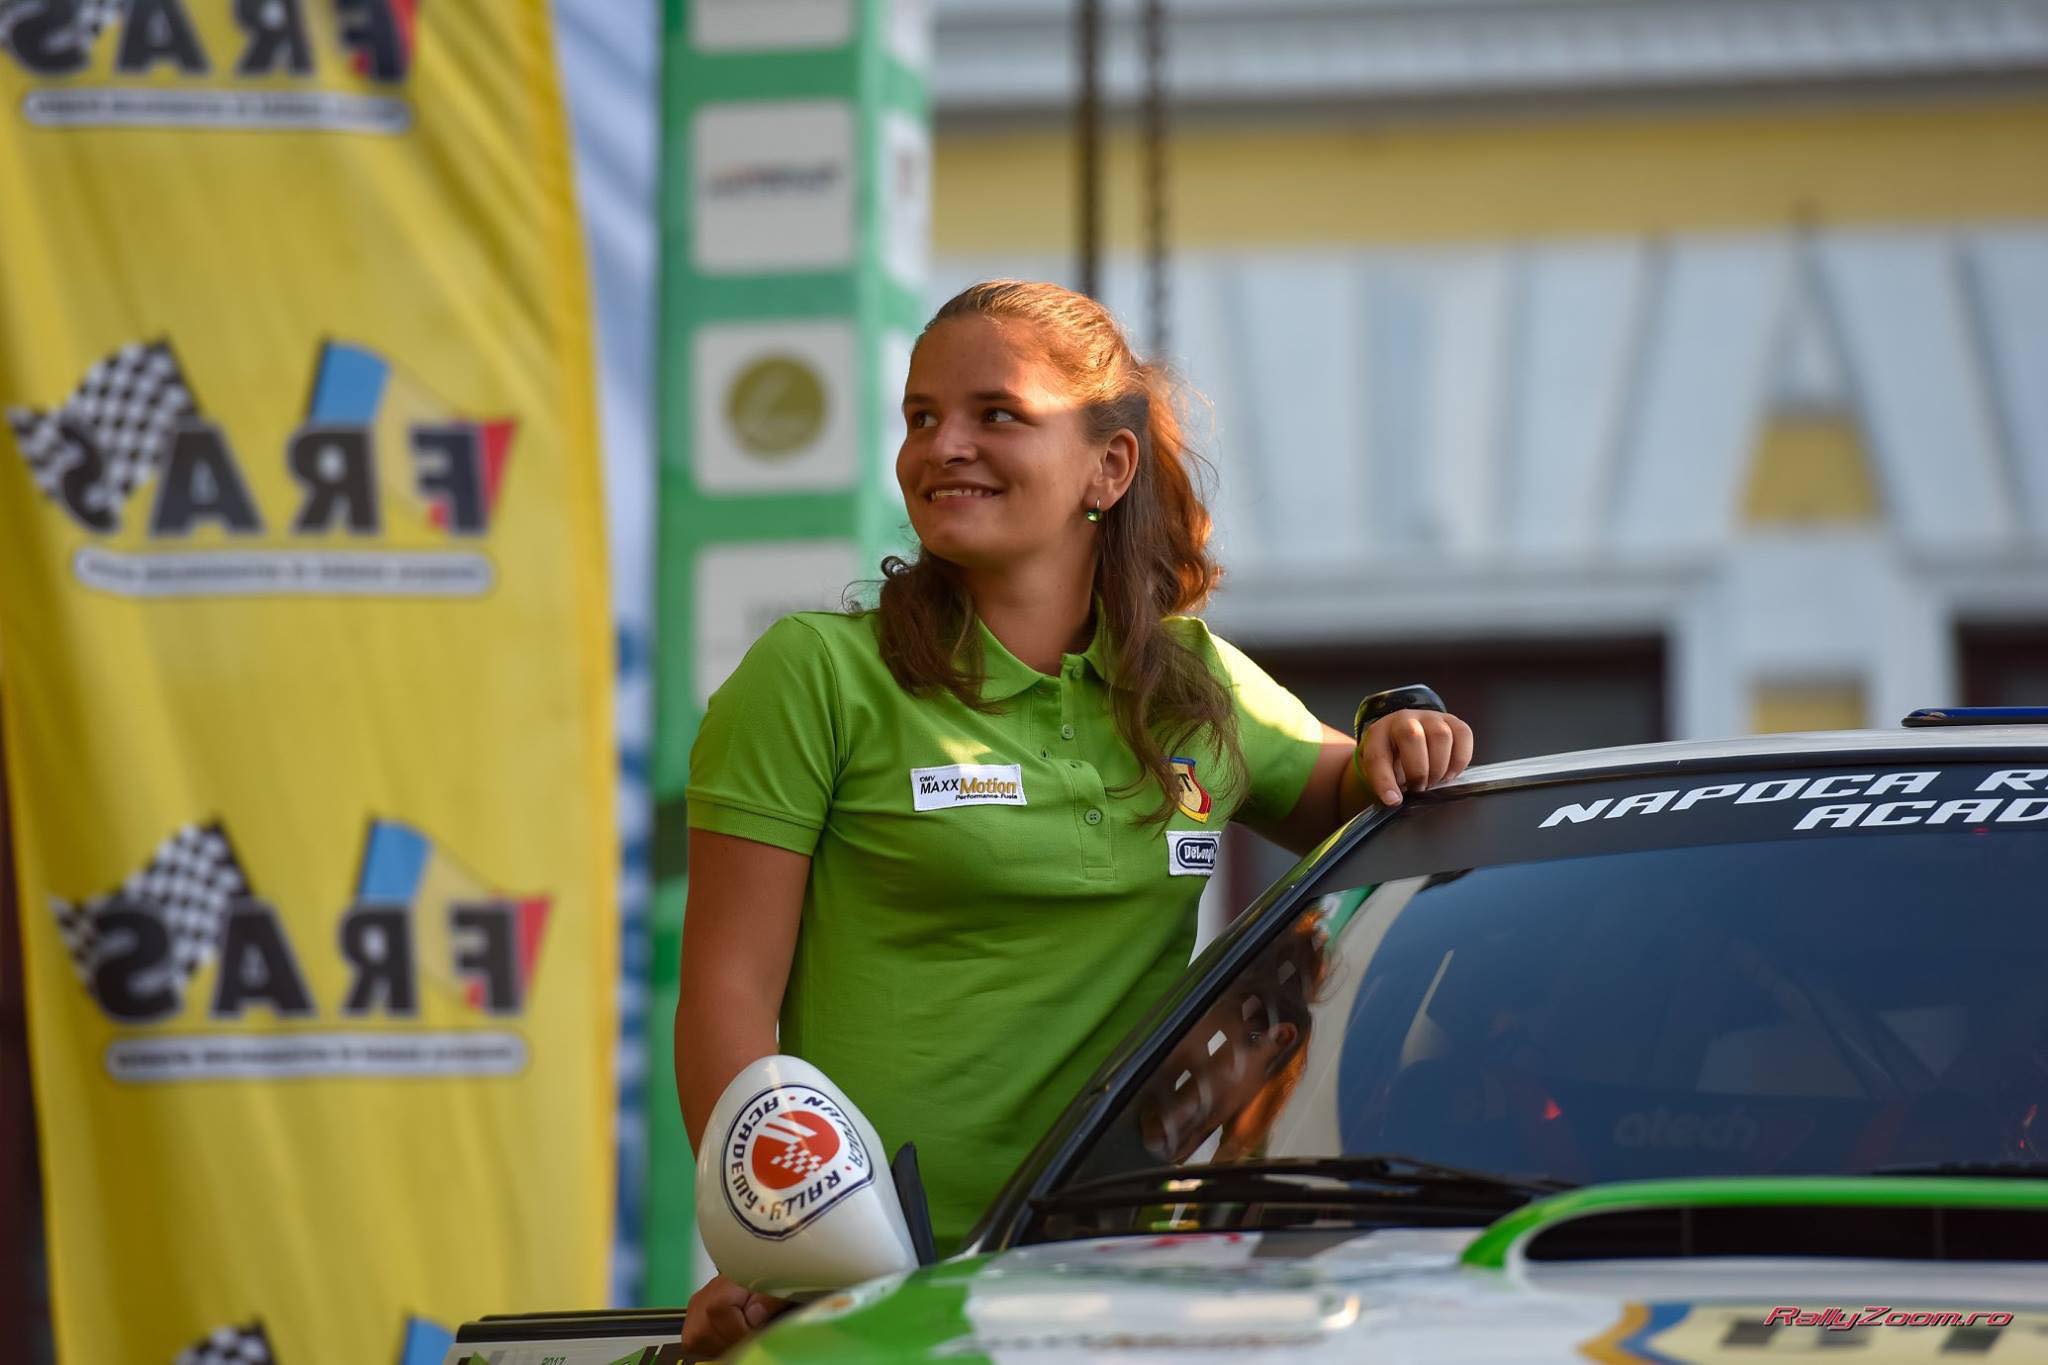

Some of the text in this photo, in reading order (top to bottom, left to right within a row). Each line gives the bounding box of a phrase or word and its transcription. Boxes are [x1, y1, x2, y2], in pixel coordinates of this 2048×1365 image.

[919, 775, 936, 783] OMV
[1538, 768, 2048, 829] NAPOCA R
[731, 1096, 780, 1210] ACADEMY
[803, 1096, 864, 1168] NAPOCA
[770, 1169, 842, 1221] RALLY
